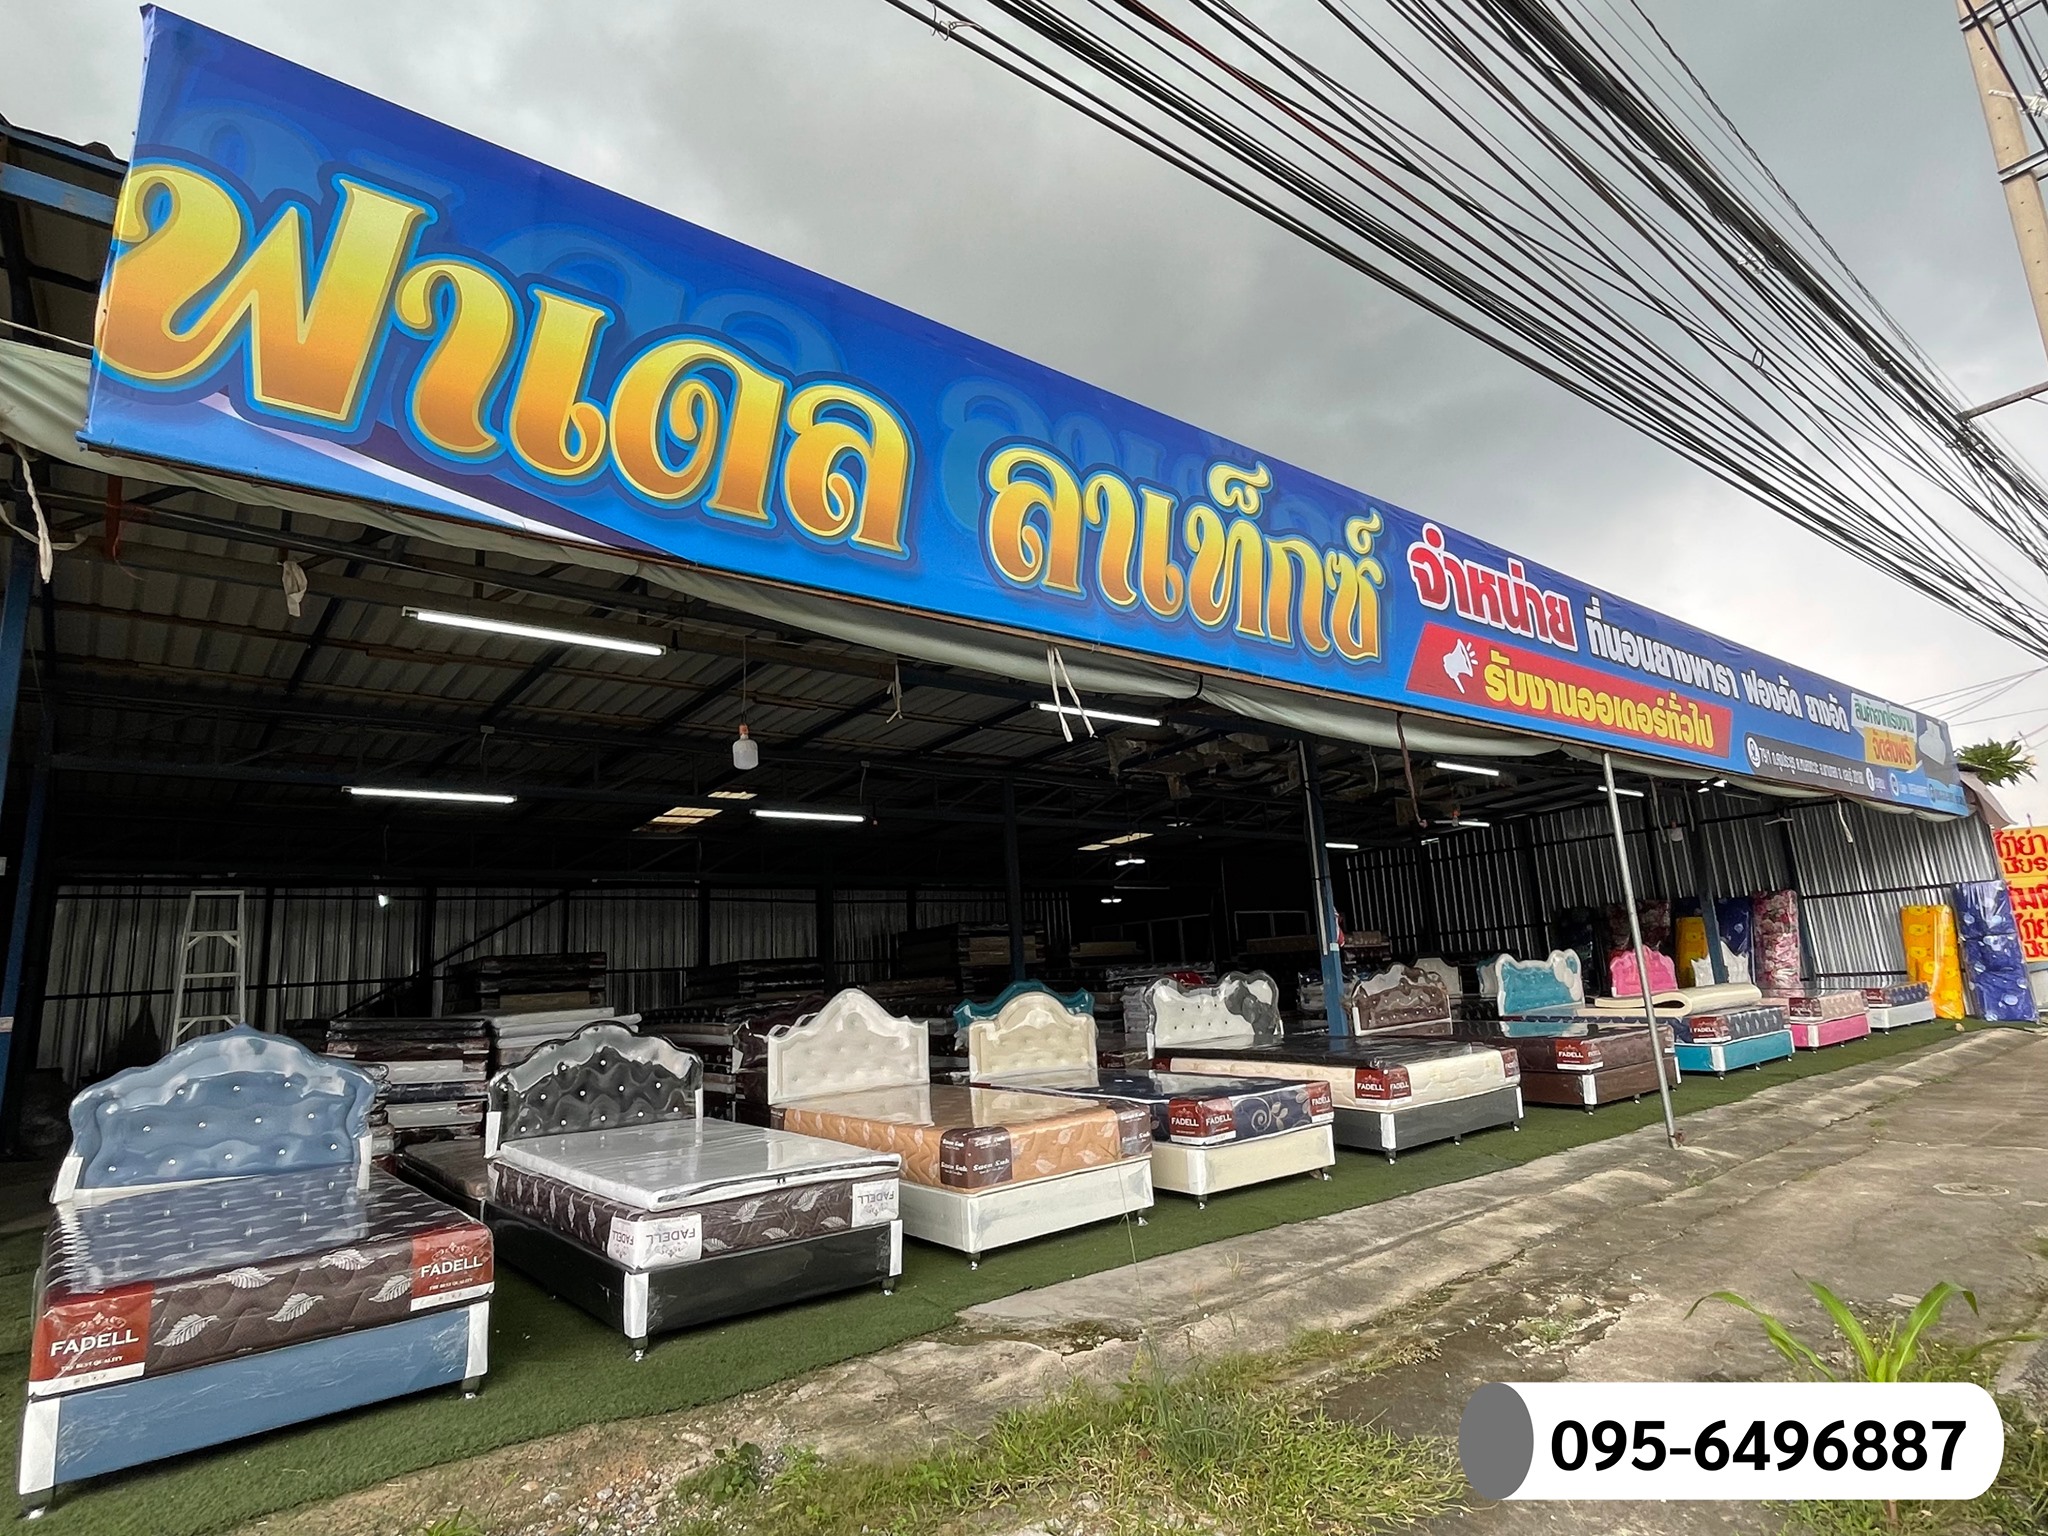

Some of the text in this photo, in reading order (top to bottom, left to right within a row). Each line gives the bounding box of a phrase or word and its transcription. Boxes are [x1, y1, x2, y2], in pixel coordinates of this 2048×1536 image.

[95, 163, 1385, 660] ฟาเดล ลาเท็กซ์
[1408, 523, 1578, 652] จำหน่าย
[1584, 596, 1740, 699] ที่นอนยางพารา
[1484, 650, 1714, 749] รับงานออเดอร์ทั่วไป
[1356, 1082, 1385, 1091] FADELL
[1171, 1117, 1199, 1127] FADELL
[1205, 1113, 1232, 1126] FADELL
[857, 1190, 895, 1204] FADELL
[612, 1230, 634, 1246] FADELL
[646, 1228, 695, 1243] FADELL
[421, 1256, 483, 1278] FADELL
[50, 1329, 139, 1357] FADELL
